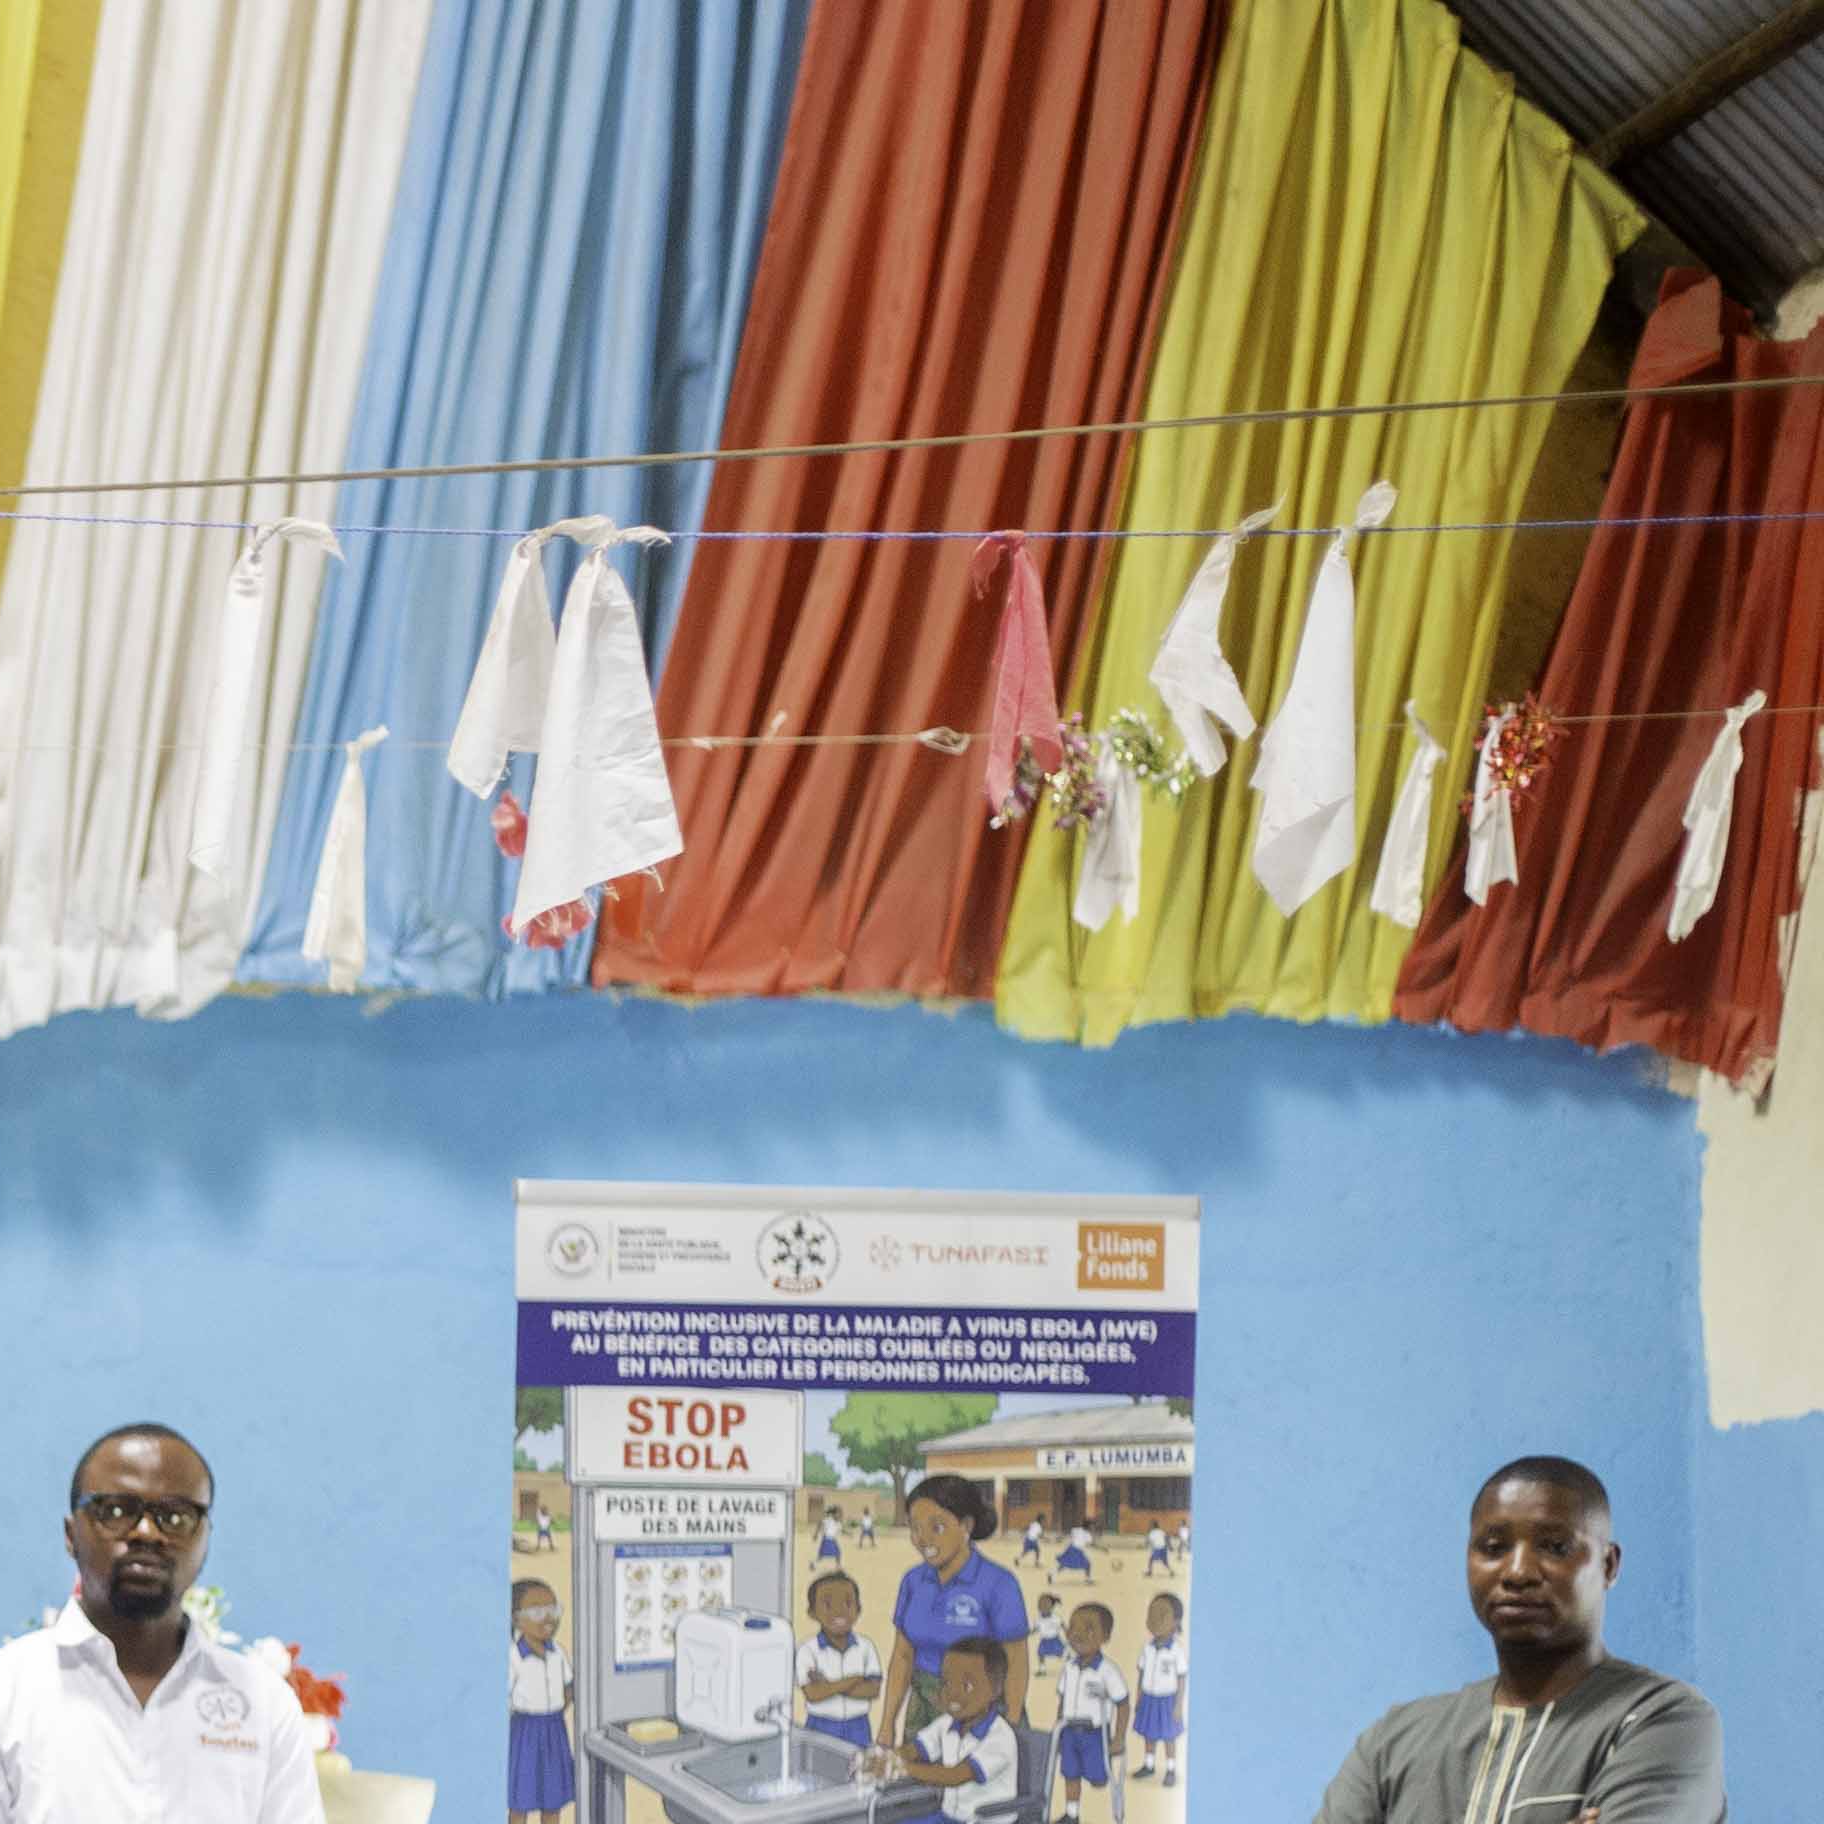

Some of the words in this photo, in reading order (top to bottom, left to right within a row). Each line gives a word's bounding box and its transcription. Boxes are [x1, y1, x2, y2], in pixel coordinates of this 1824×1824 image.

[1087, 1232, 1157, 1257] Liliane
[1088, 1257, 1149, 1281] Fonds
[684, 1311, 789, 1334] INCLUSIVE
[793, 1313, 820, 1336] DE
[824, 1314, 849, 1336] LA
[855, 1315, 943, 1337] MALADIE
[966, 1316, 1027, 1338] VIRUS
[1032, 1318, 1096, 1340] EBOLA
[1100, 1318, 1158, 1345] (MVE)
[571, 1333, 600, 1355] AU
[710, 1335, 749, 1357] DES
[980, 1339, 1012, 1361] OU
[617, 1356, 645, 1378] EN
[650, 1357, 778, 1380] PARTICULIER
[782, 1359, 816, 1381] LES
[821, 1359, 940, 1383] PERSONNES
[627, 1396, 747, 1438] STOP
[623, 1441, 750, 1472] EBOLA
[1089, 1447, 1187, 1466] LUMUMBA
[606, 1496, 669, 1514] POSTE
[677, 1498, 697, 1514] DE
[708, 1498, 777, 1515] LAVAGE
[642, 1517, 679, 1534] DES
[686, 1518, 748, 1535] MAINS
